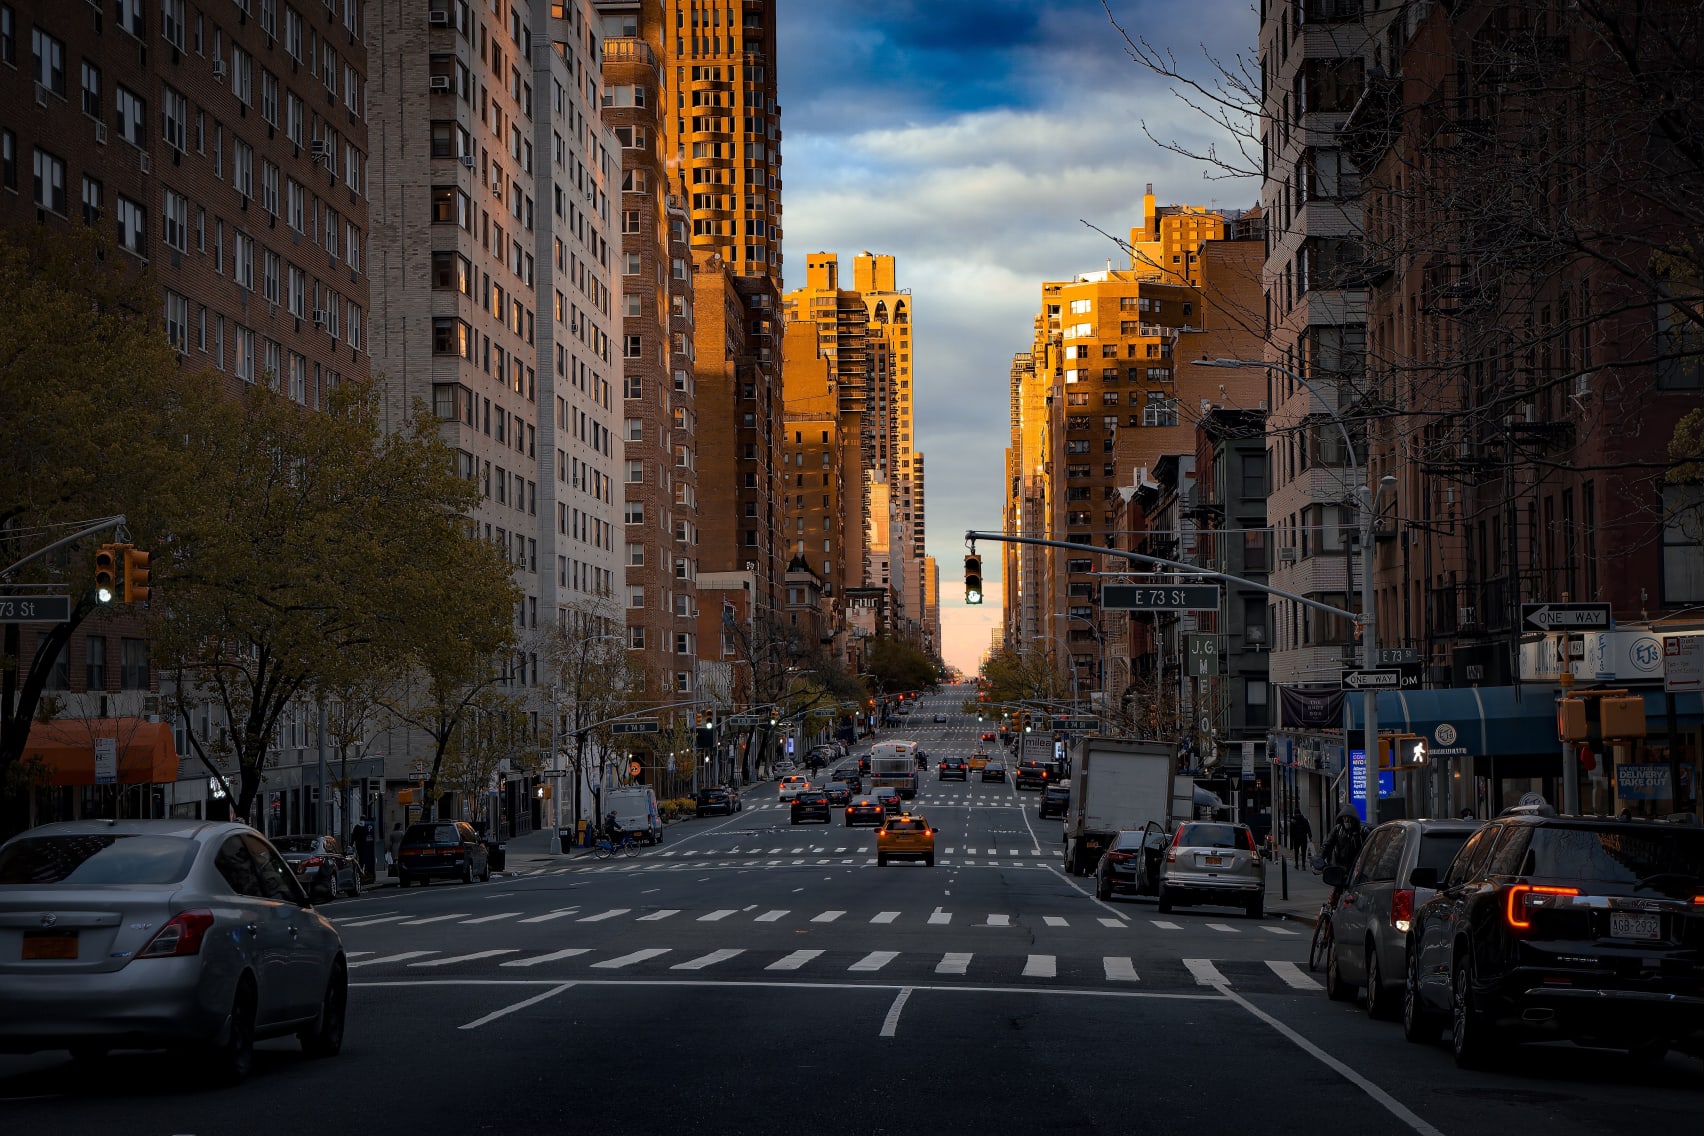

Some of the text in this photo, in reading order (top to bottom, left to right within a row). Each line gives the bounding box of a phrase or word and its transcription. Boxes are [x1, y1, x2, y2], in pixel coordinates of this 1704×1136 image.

[1135, 590, 1186, 605] E 73 St
[0, 601, 36, 617] 73 St
[1539, 612, 1601, 623] ONE WAY
[1191, 640, 1217, 655] J.G.
[1382, 650, 1388, 662] E
[1391, 650, 1402, 662] 73
[1351, 674, 1393, 684] ONE WAY
[1025, 737, 1052, 747] milea
[1618, 778, 1667, 786] TAKE OUT
